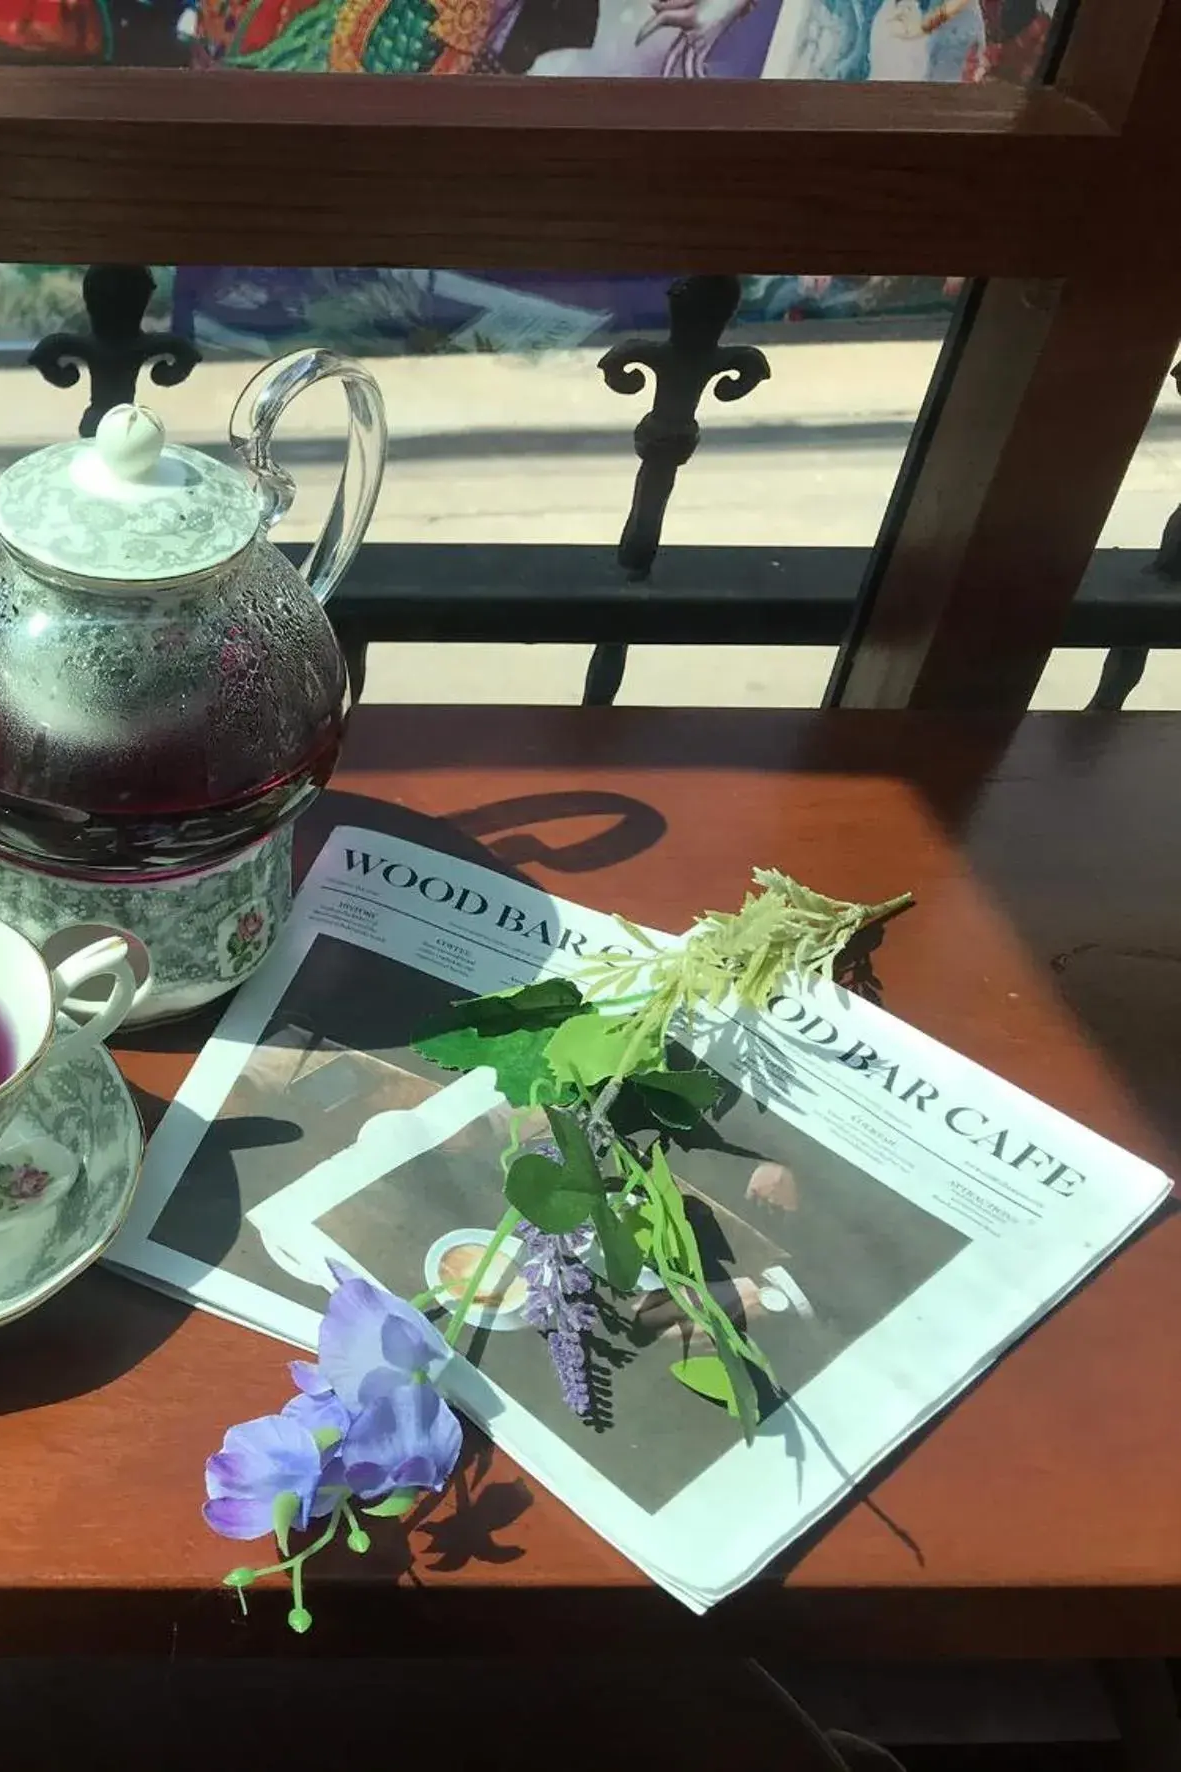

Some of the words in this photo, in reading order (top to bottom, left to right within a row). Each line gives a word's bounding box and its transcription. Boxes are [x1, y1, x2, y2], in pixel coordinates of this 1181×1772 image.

[344, 848, 489, 916] WOOD
[495, 905, 588, 956] BAR
[766, 994, 839, 1045] OD
[837, 1040, 940, 1112] BAR
[945, 1106, 1087, 1198] CAFE
